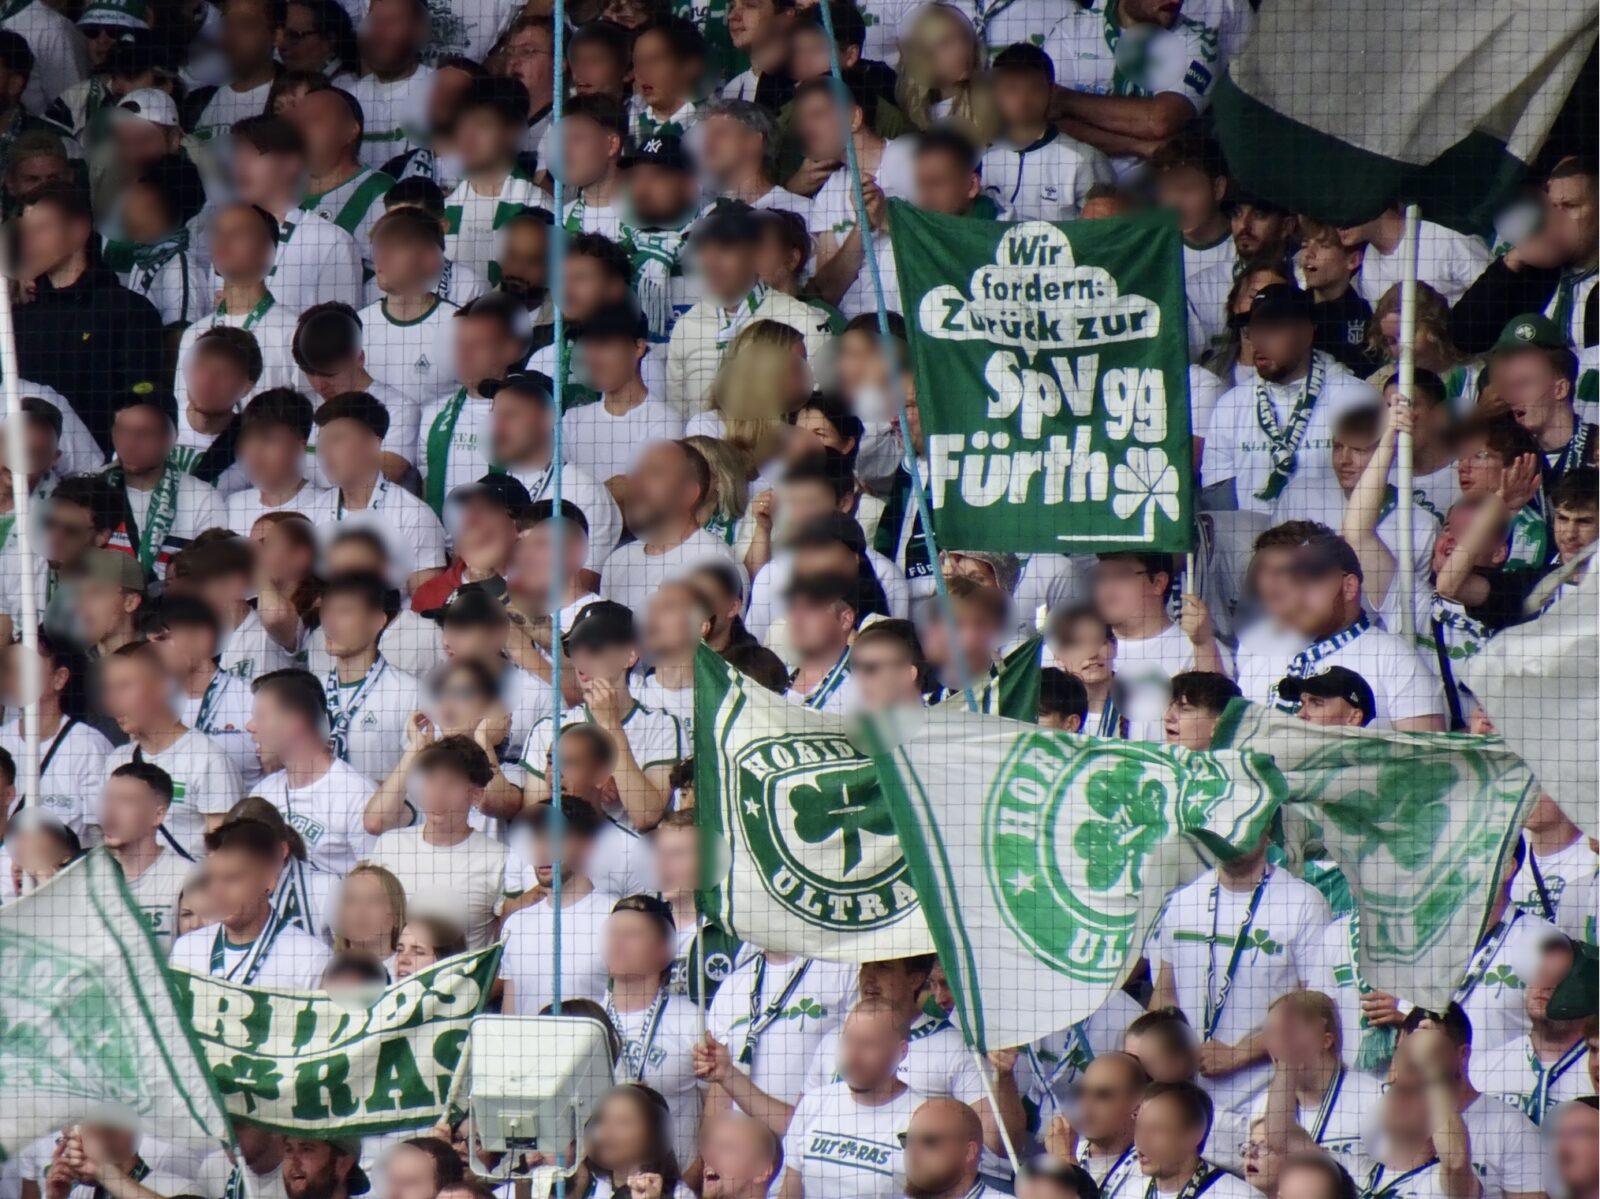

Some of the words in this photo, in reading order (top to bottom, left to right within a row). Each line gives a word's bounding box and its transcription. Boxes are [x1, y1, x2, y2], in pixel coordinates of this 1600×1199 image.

[1008, 234, 1066, 266] Wir
[982, 273, 1105, 302] fordern:
[940, 298, 1063, 342] Zurück
[1076, 310, 1148, 340] zur
[930, 424, 1109, 509] Fürth
[1067, 926, 1130, 969] UL
